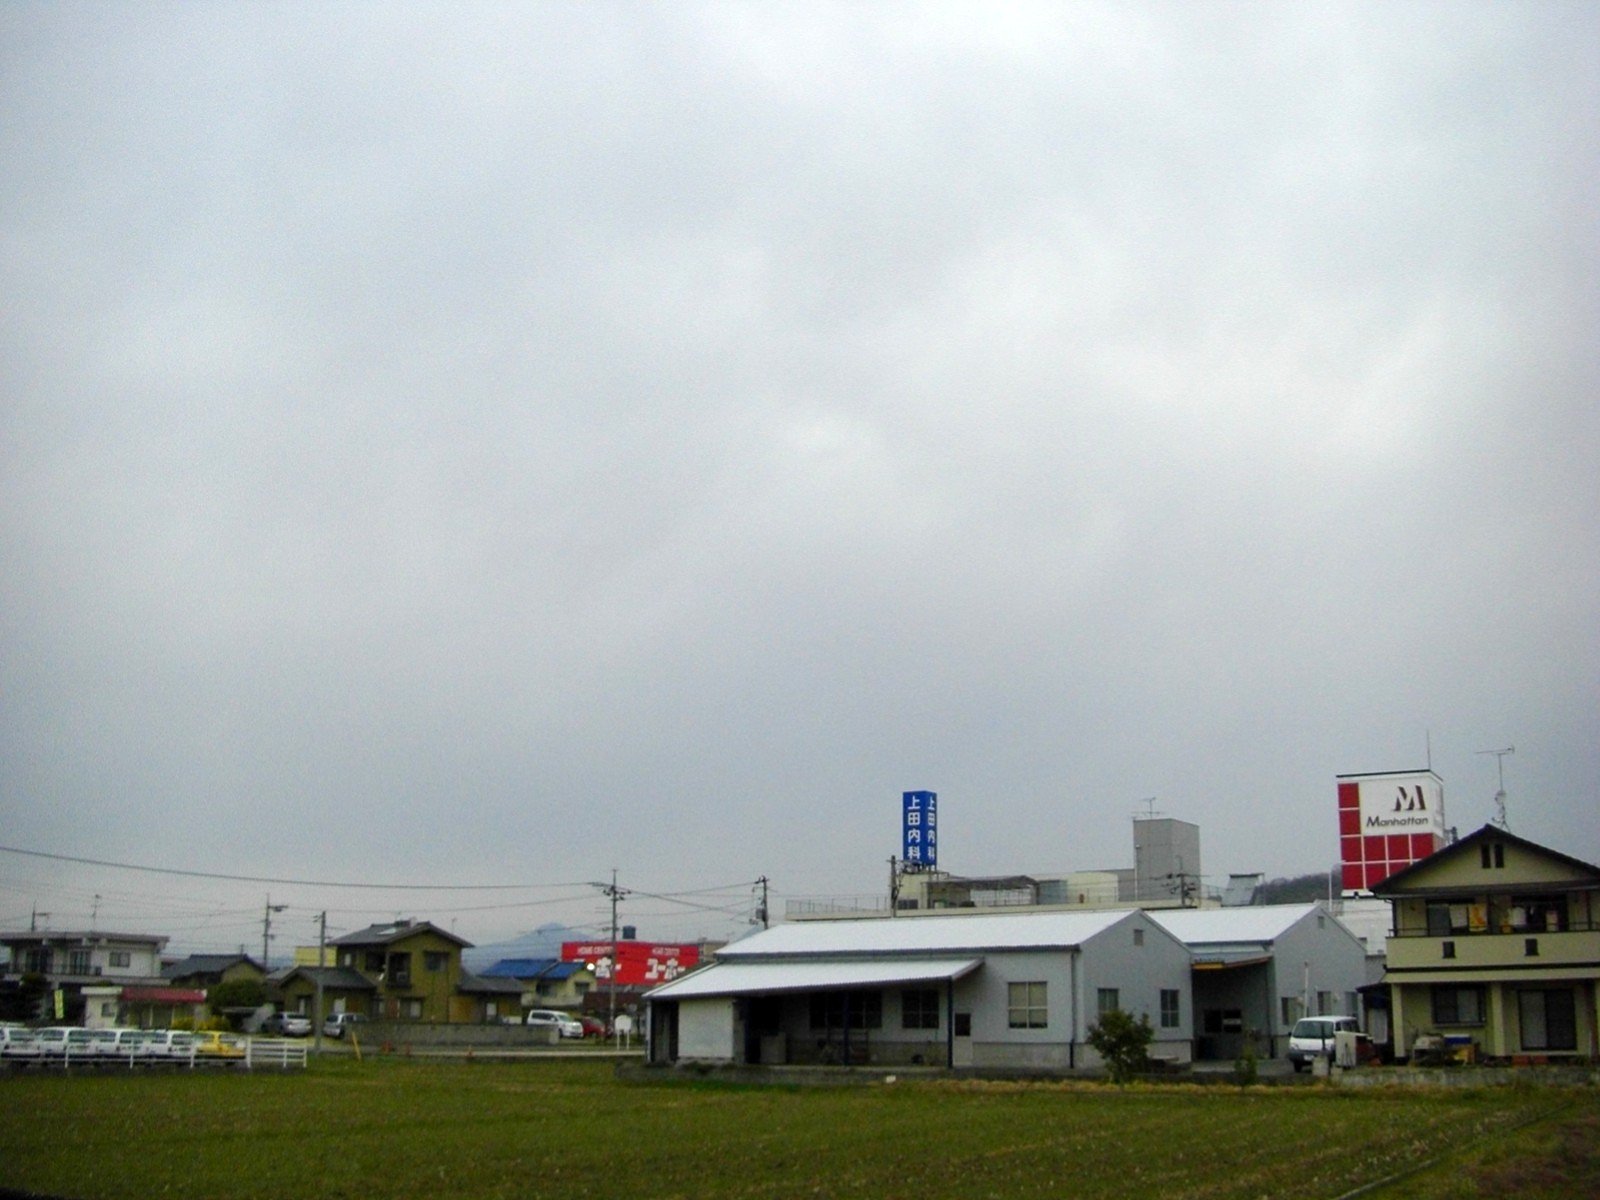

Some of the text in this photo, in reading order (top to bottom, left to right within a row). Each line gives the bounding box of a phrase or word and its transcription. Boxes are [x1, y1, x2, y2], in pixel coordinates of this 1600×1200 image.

[908, 795, 921, 860] 上田内科
[927, 796, 935, 860] 上田内科
[1366, 815, 1429, 828] Manhattan
[645, 958, 686, 980] ユーホー
